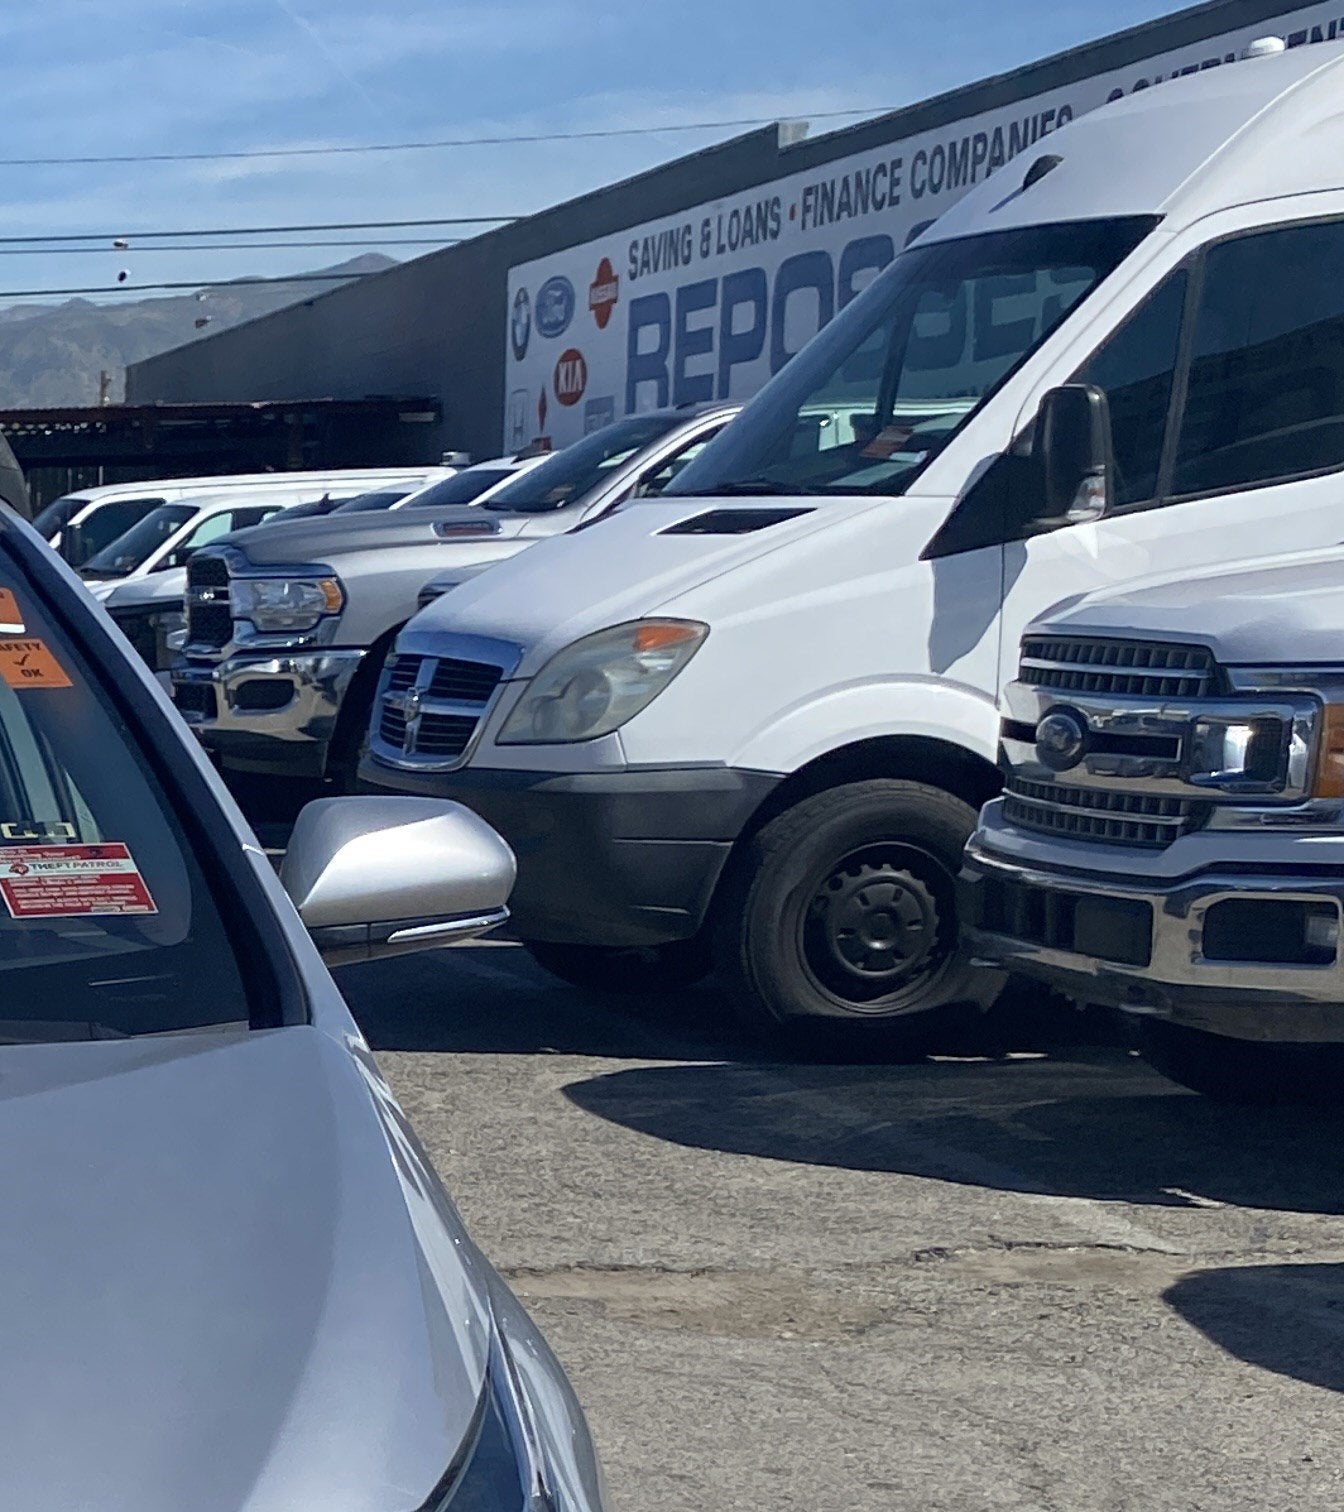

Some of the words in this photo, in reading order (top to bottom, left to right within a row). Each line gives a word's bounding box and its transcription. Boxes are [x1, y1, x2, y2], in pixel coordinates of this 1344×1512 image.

[628, 224, 692, 281] SAVING
[700, 217, 711, 259] &
[715, 196, 782, 255] LOANS
[801, 157, 903, 230] FINANCE
[558, 358, 584, 394] KIA
[21, 669, 44, 678] OK
